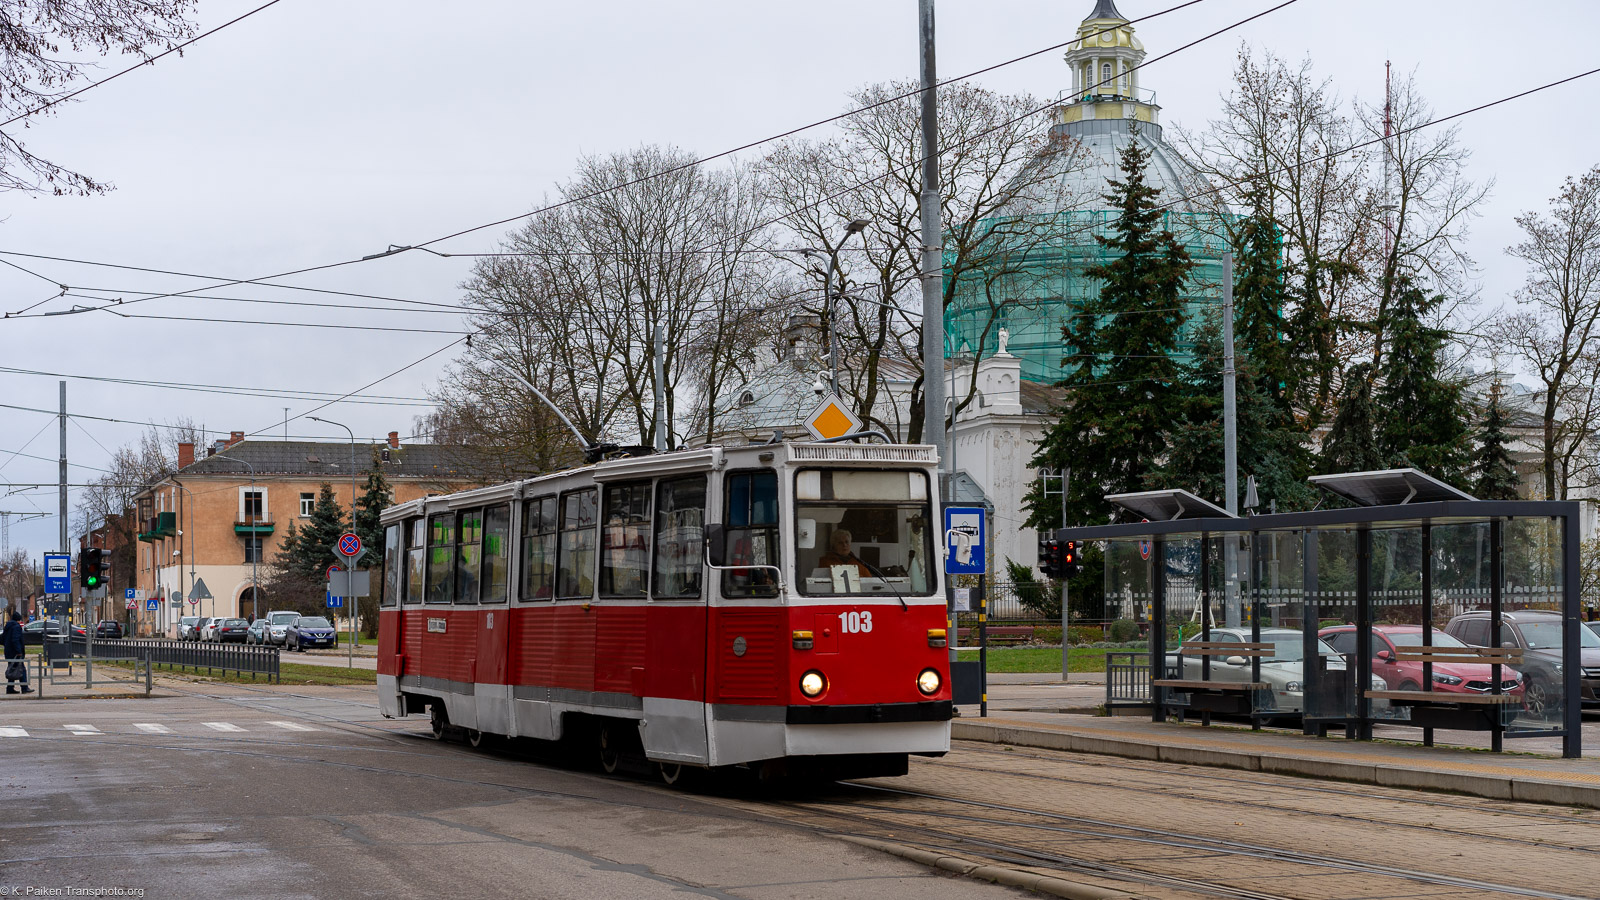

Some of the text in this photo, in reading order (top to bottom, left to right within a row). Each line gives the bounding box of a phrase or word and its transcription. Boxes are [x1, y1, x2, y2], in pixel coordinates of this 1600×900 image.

[1068, 542, 1074, 550] 5
[840, 570, 851, 593] 1
[127, 589, 133, 597] P
[838, 611, 873, 633] 103
